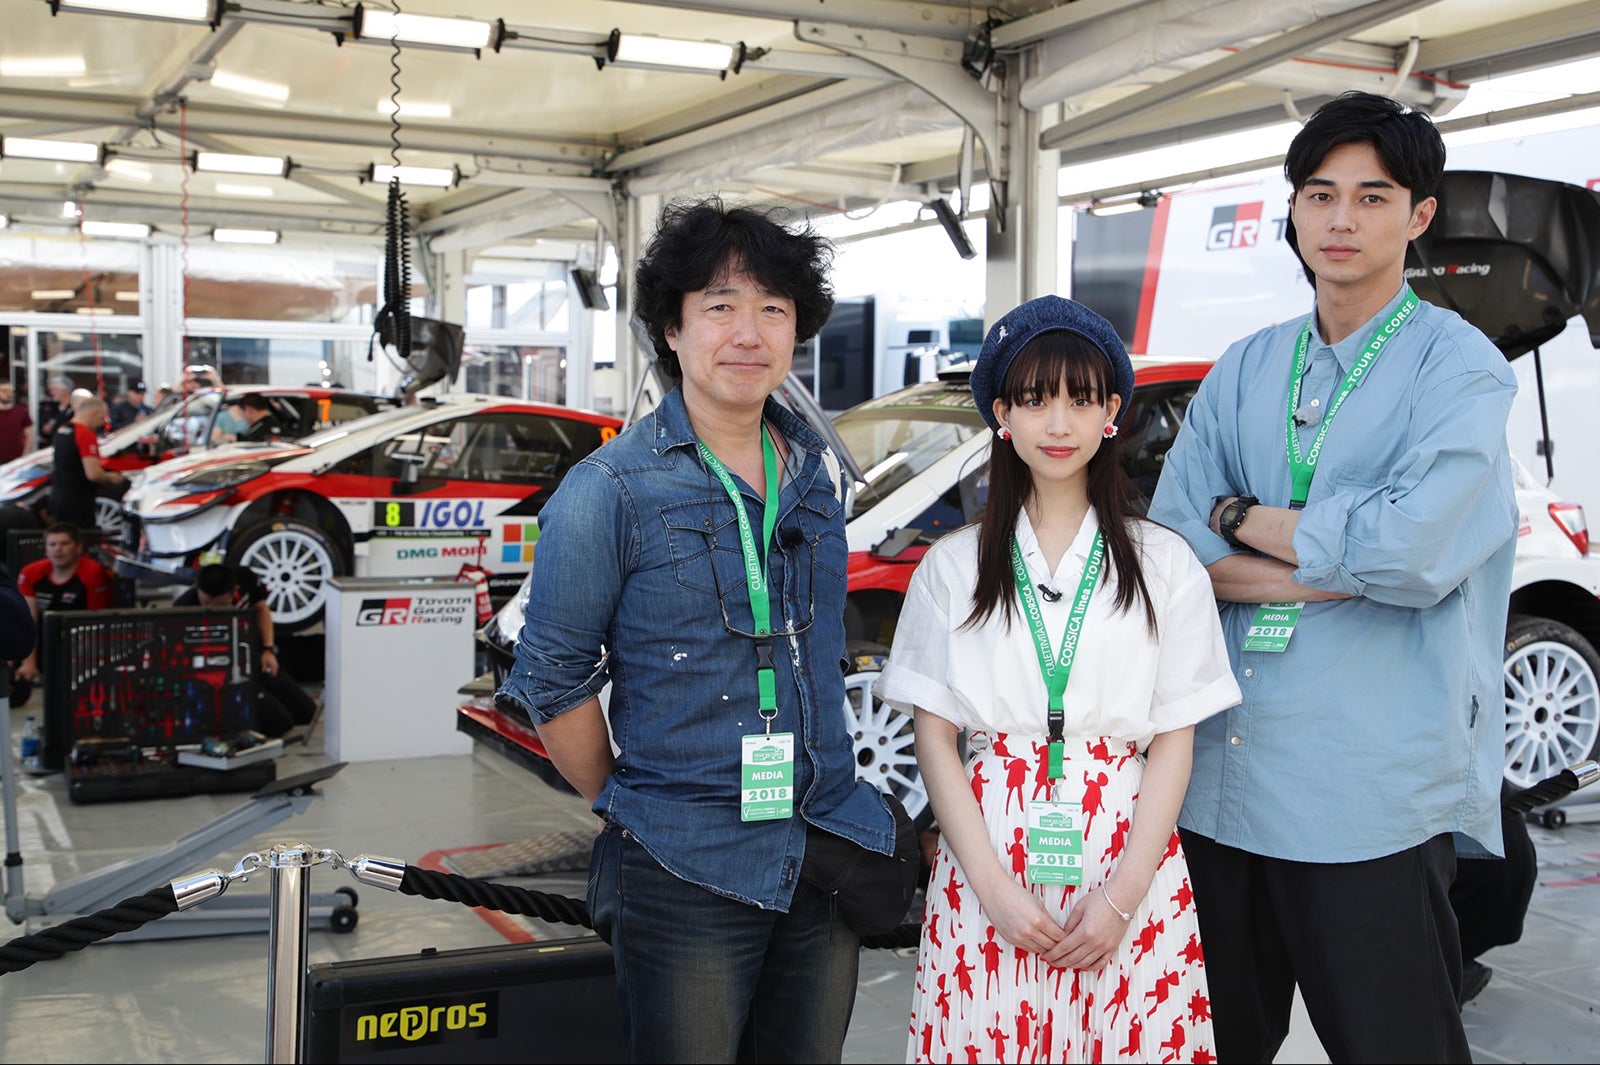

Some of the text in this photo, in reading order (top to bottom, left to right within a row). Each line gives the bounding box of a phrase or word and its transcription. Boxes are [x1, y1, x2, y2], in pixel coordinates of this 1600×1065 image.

[1206, 218, 1262, 250] GR
[1447, 263, 1491, 276] Racing
[1307, 417, 1333, 466] CORSICA
[1347, 352, 1374, 384] TOUR
[1371, 334, 1387, 350] DE
[1385, 300, 1415, 334] CORSE
[317, 399, 332, 422] 7
[386, 502, 400, 527] 8
[421, 501, 485, 527] IGOL
[731, 490, 749, 530] CORSICA
[396, 548, 438, 560] DMG
[744, 539, 761, 591] CULLETTIVITÀ
[414, 606, 466, 614] GAZOO
[415, 597, 472, 605] TOYOTA
[1022, 584, 1040, 621] CORSICA
[1060, 616, 1082, 667] CORSICA
[1073, 590, 1091, 615] linea
[1085, 550, 1103, 584] TOUR
[357, 607, 408, 627] GR
[411, 615, 462, 625] Racing
[1253, 628, 1288, 636] 2018
[752, 771, 784, 781] MEDIA
[749, 789, 787, 801] 2018
[1039, 837, 1072, 847] MEDIA
[1036, 854, 1076, 866] 2018
[356, 1002, 487, 1041] nepros
